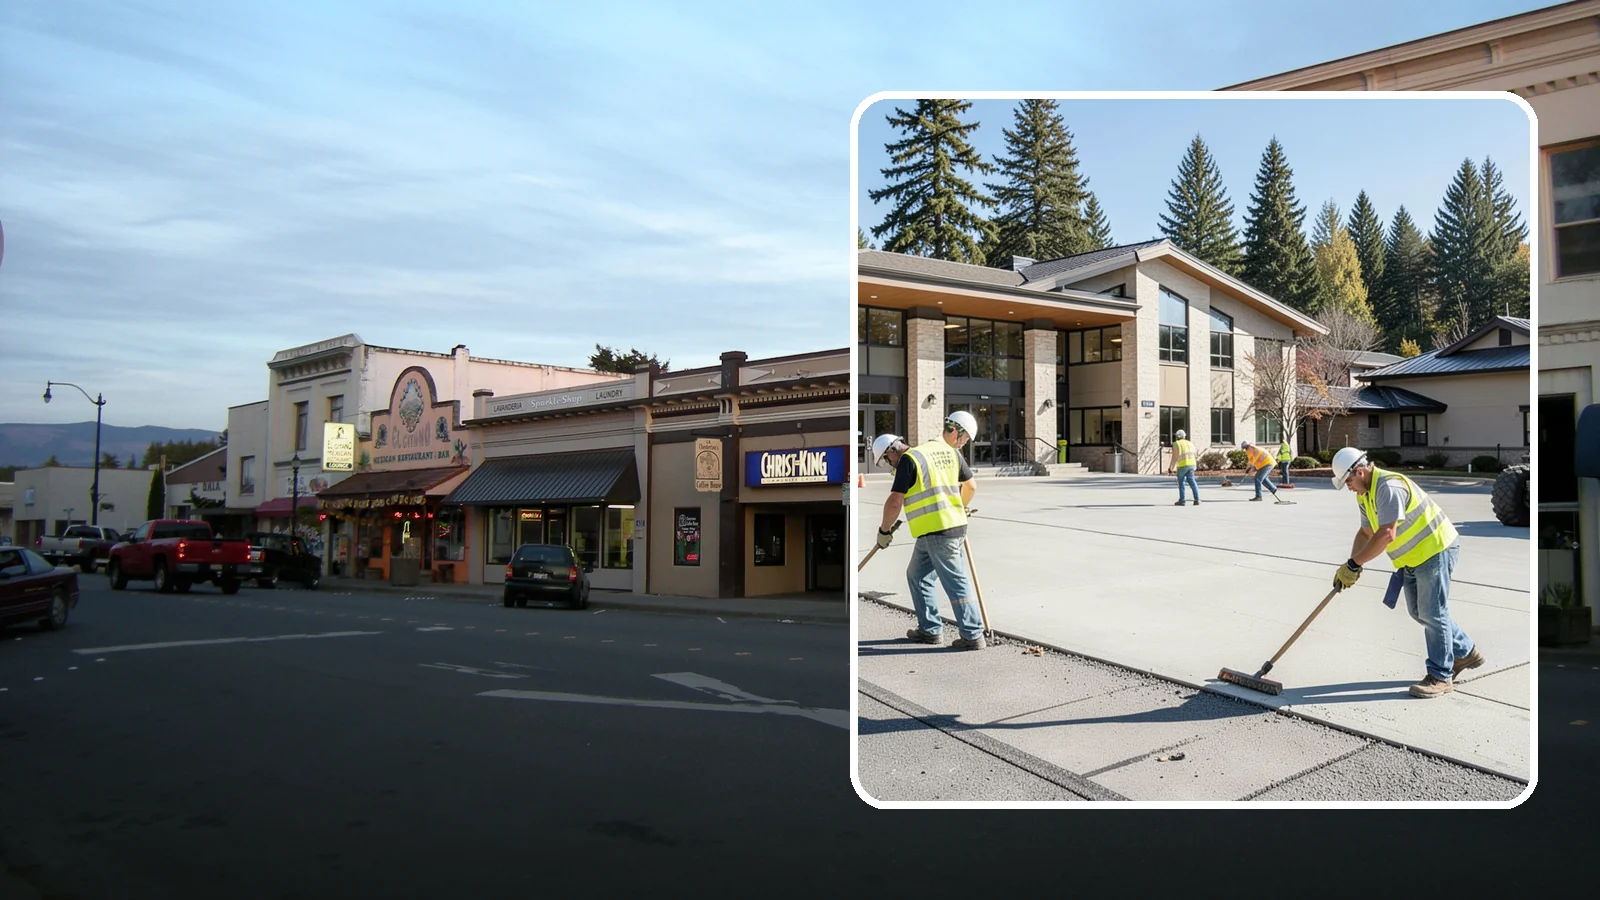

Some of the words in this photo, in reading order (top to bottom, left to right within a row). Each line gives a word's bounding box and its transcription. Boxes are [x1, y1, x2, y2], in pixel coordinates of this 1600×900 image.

[493, 402, 523, 412] LAVANDERIA
[531, 397, 561, 409] Sparkle
[562, 394, 582, 405] Shop
[595, 388, 624, 400] LAUNDRY
[373, 454, 397, 464] MEXICAN
[397, 451, 433, 463] RESTAURANT
[437, 450, 450, 459] BAR
[760, 452, 797, 478] CHRIST
[799, 450, 827, 476] KING
